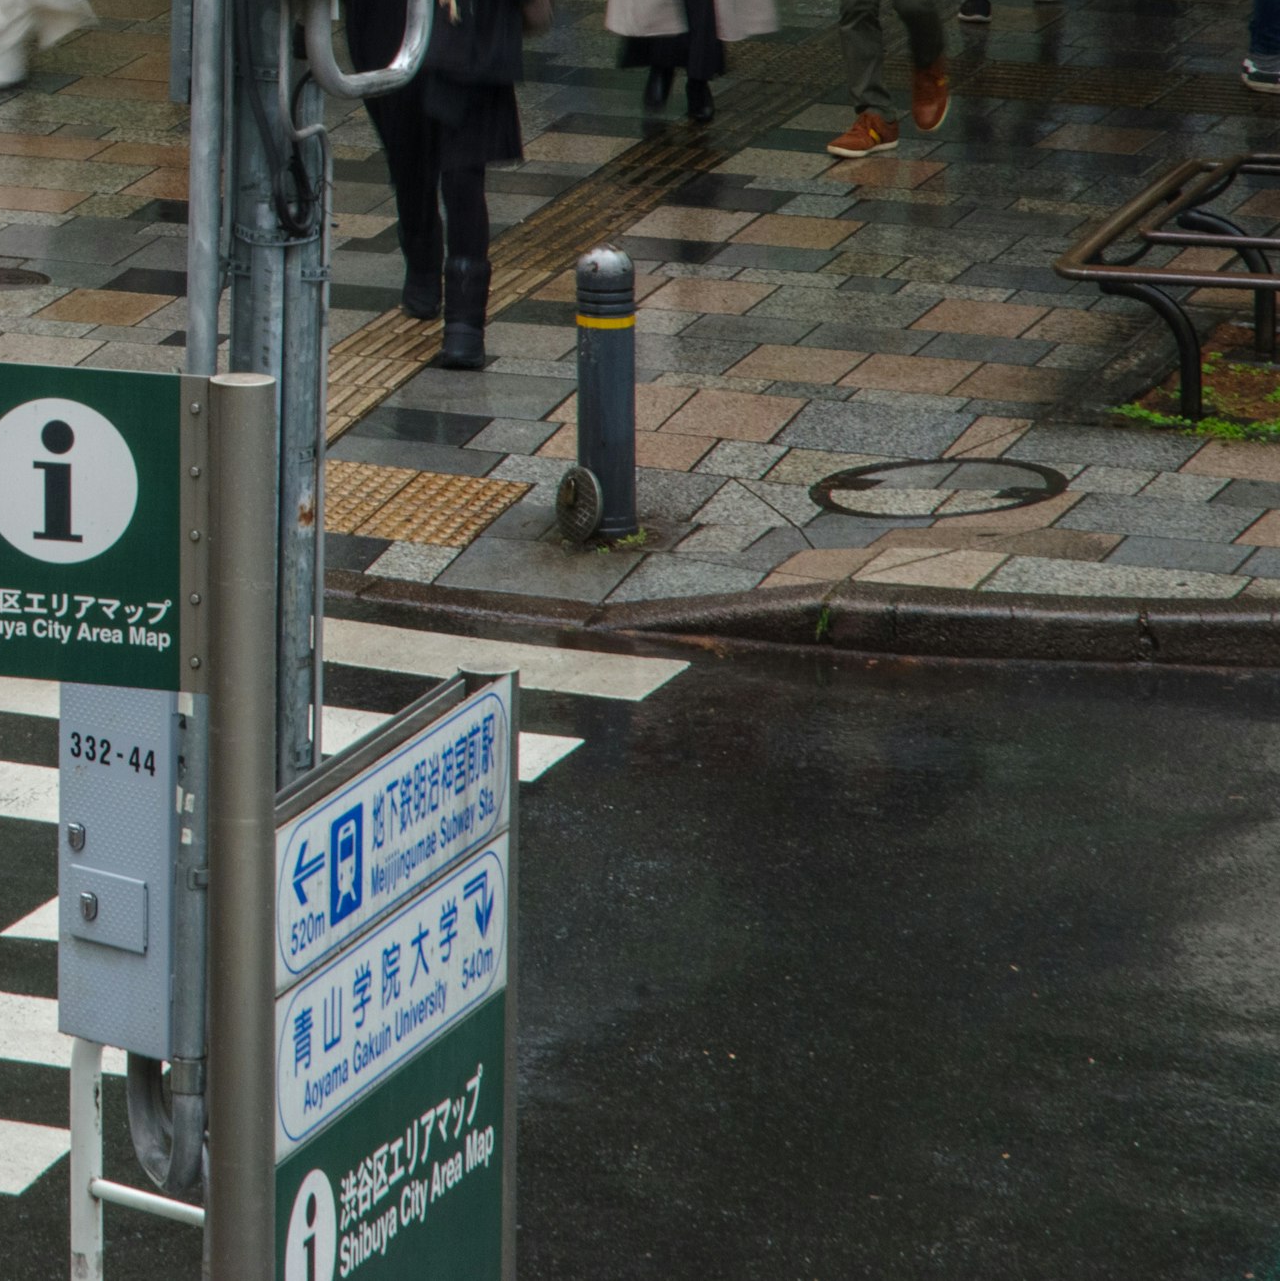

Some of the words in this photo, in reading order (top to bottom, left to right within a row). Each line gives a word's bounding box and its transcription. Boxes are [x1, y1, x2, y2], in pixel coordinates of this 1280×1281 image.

[32, 619, 72, 644] City
[77, 622, 123, 644] Area
[129, 626, 171, 652] Map
[71, 731, 155, 777] 332-44
[372, 713, 494, 852] 地下鉄明治神宮前駅
[440, 803, 476, 847] Subway
[291, 911, 325, 956] 520m
[462, 947, 494, 991] 540m
[293, 896, 458, 1077] 青山学院大学
[303, 1057, 349, 1115] Aoyama
[353, 1025, 391, 1073] Gakuin
[395, 981, 447, 1043] University
[340, 1062, 484, 1231] 渋谷区エリアマップ
[340, 1206, 397, 1278] Shibuya
[400, 1178, 428, 1223] City
[431, 1151, 463, 1203] Area
[466, 1125, 494, 1173] Map
